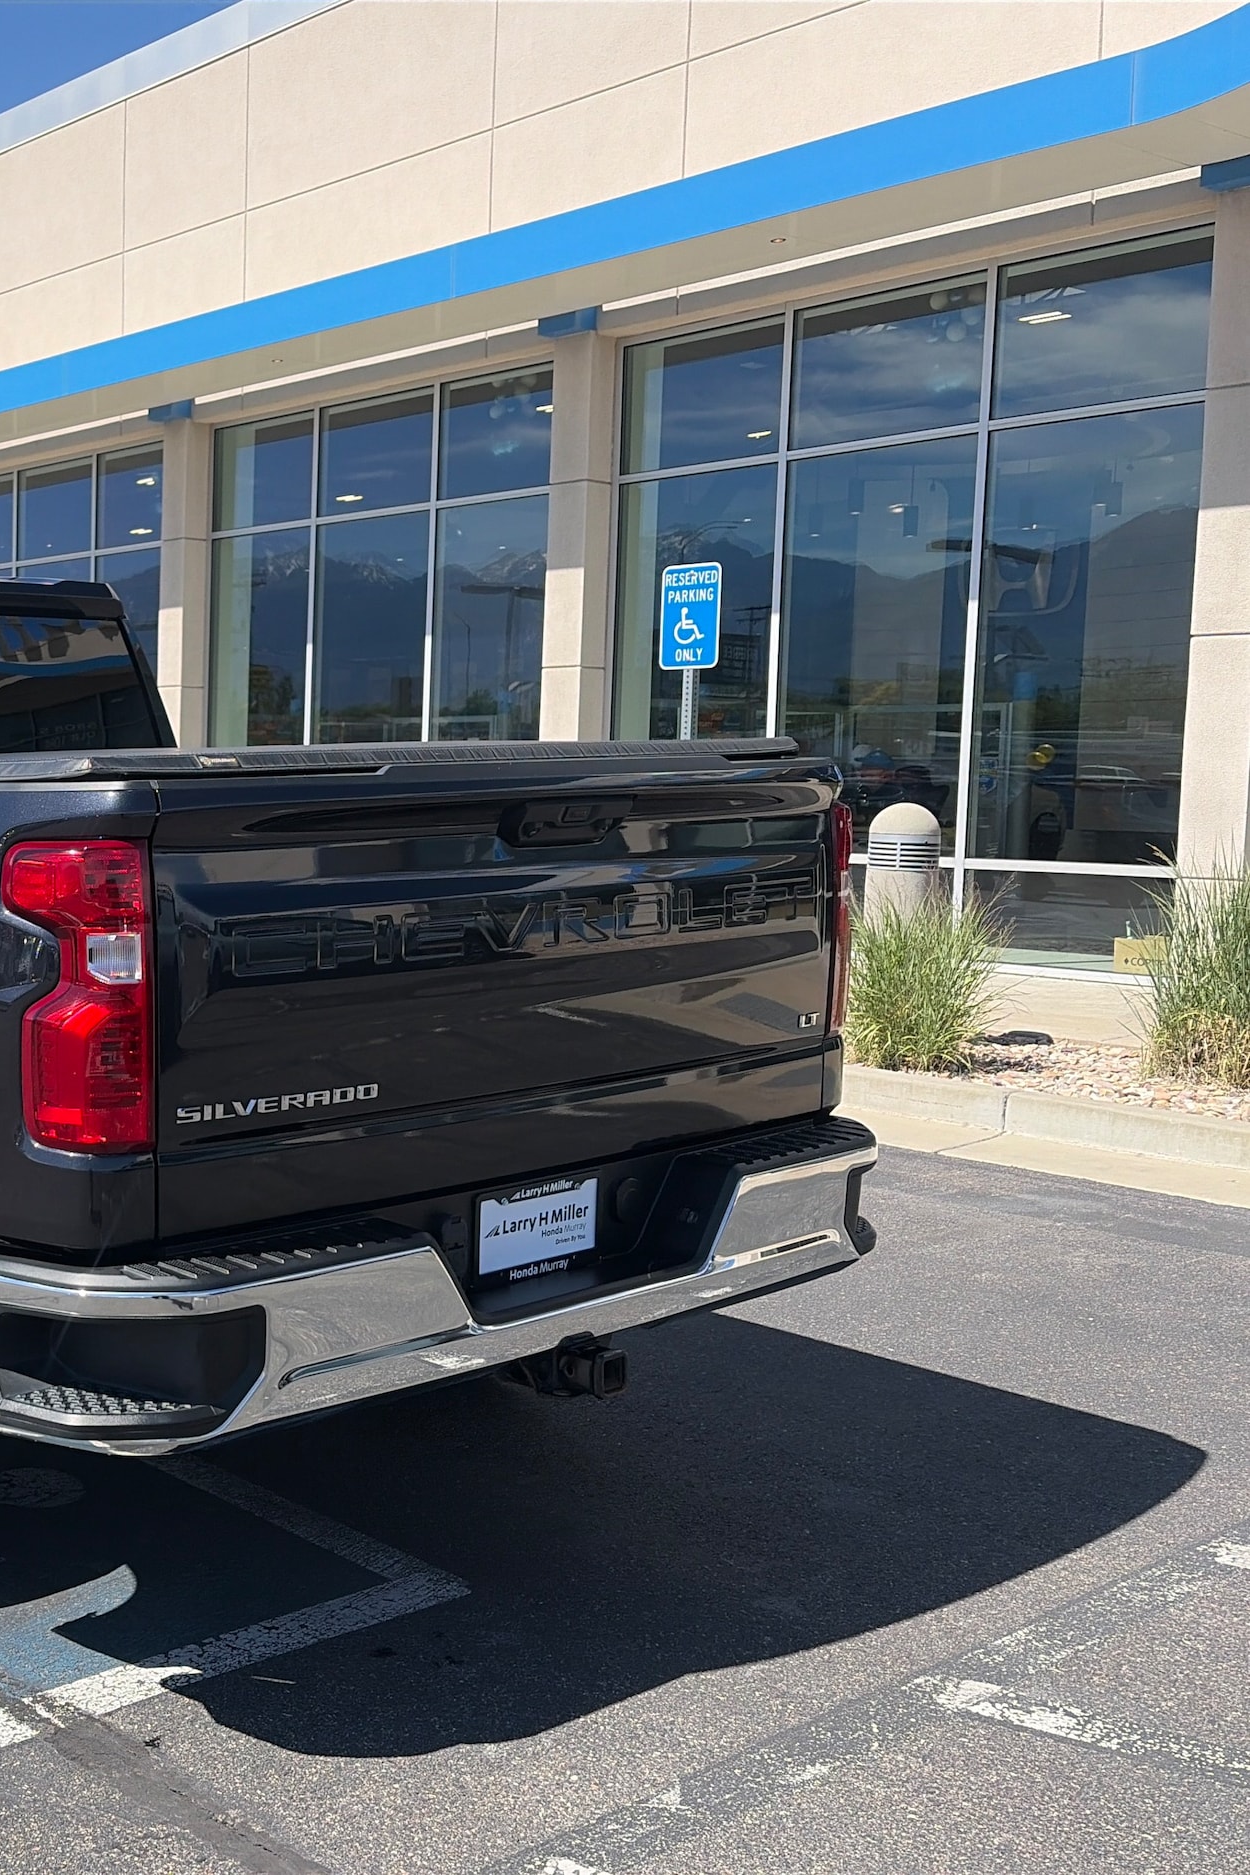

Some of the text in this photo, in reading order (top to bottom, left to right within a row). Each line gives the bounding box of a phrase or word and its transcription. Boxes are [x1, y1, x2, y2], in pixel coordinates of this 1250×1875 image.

[665, 570, 718, 587] RESERVED
[668, 587, 714, 604] PARKING
[675, 647, 703, 662] ONLY
[232, 867, 817, 978] CHEVROLET
[798, 1011, 820, 1028] LT
[176, 1083, 379, 1124] SILVERADO
[521, 1179, 573, 1198] Larry H Miller
[502, 1203, 589, 1235] Larry H Miller
[541, 1223, 587, 1238] Honda Murray
[510, 1259, 569, 1280] Honda Murray
